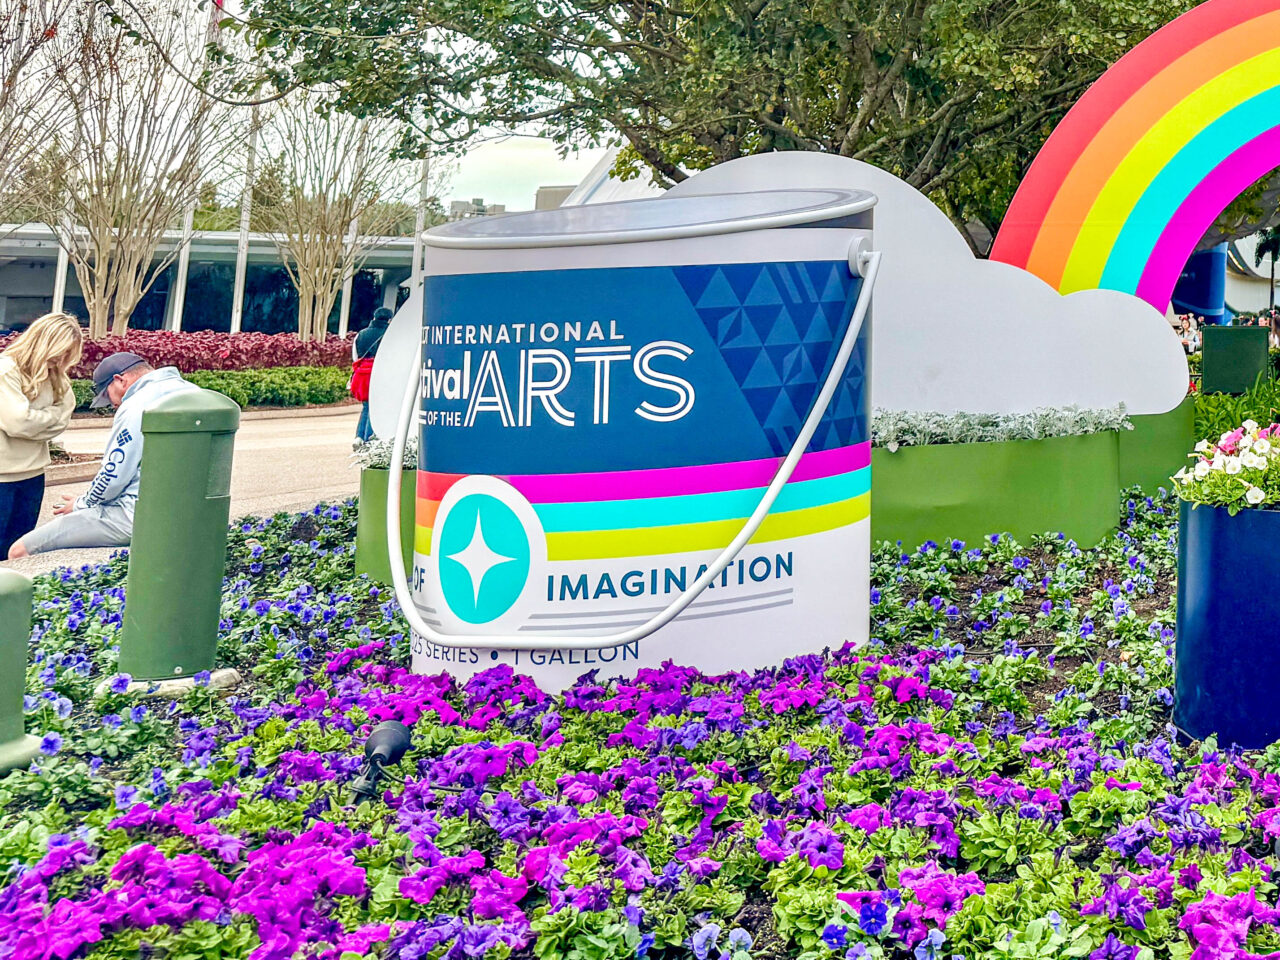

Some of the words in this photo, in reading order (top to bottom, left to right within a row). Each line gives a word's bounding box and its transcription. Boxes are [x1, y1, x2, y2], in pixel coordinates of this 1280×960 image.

[431, 320, 625, 345] INTERNATIONAL
[463, 340, 696, 428] ARTS
[427, 410, 439, 425] OF
[440, 411, 462, 427] THE
[413, 565, 426, 593] OF
[425, 640, 479, 664] SERIES
[529, 640, 640, 666] GALLON
